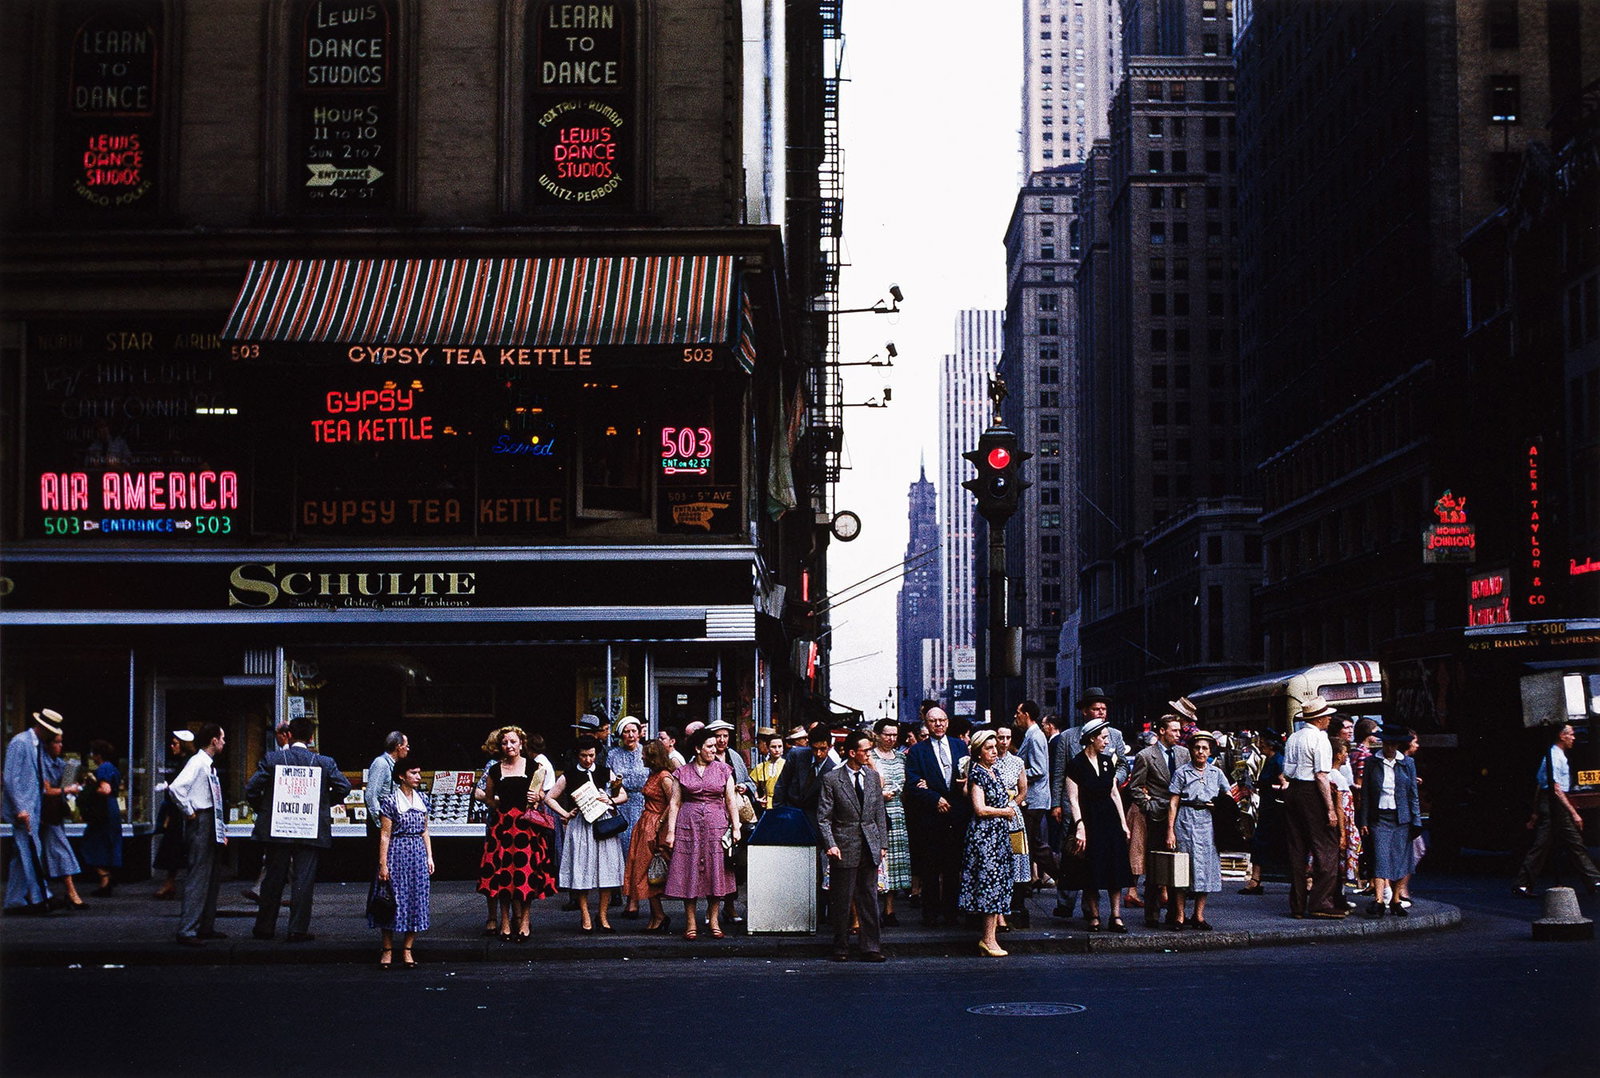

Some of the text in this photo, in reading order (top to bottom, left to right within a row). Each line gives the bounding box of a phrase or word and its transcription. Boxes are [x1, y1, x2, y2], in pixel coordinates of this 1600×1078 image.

[317, 2, 377, 28] LEWIS
[549, 4, 614, 29] LEARN
[83, 30, 147, 54] LEARN
[309, 38, 382, 58] DANCE
[565, 37, 595, 51] TO
[97, 63, 127, 76] TO
[308, 65, 382, 84] STUDIOS
[543, 61, 617, 84] DANCE
[76, 85, 148, 109] DANCE
[314, 105, 379, 125] HOURS
[88, 133, 141, 152] LEWIS
[314, 127, 328, 140] 11
[357, 126, 378, 139] 10
[560, 126, 612, 144] LEWIS
[83, 150, 144, 169] DANCE
[343, 145, 352, 158] 2
[373, 144, 382, 158] 7
[553, 143, 617, 161] DANCE
[85, 168, 142, 186] STUDIOS
[318, 170, 371, 179] ENTRANCE
[556, 161, 613, 179] STUDIOS
[105, 331, 154, 351] STAR
[174, 332, 222, 351] AIRLIN
[231, 344, 260, 361] 503
[347, 345, 593, 366] GYPSY TEA KETTLE
[682, 347, 714, 363] 503
[325, 388, 414, 414] GYPSY
[311, 415, 434, 443] TEA KETTLE
[661, 427, 712, 458] 503
[688, 459, 698, 467] 42
[700, 458, 711, 467] ST
[1529, 445, 1539, 491] ALEX
[40, 470, 239, 512] AIR AMERICA
[713, 490, 733, 500] AVE
[303, 497, 562, 526] GYPSY TEA KETTLE
[43, 515, 233, 535] 503 ENTRANCE 503
[1436, 526, 1470, 535] HOWARD
[1530, 500, 1541, 568] TAYLOR
[228, 562, 476, 608] SCHULTE
[418, 596, 470, 607] Fashions
[1528, 594, 1546, 605] CO
[1494, 635, 1600, 648] RAILWAY EXPRESS
[277, 801, 314, 815] LOCKED OUT
